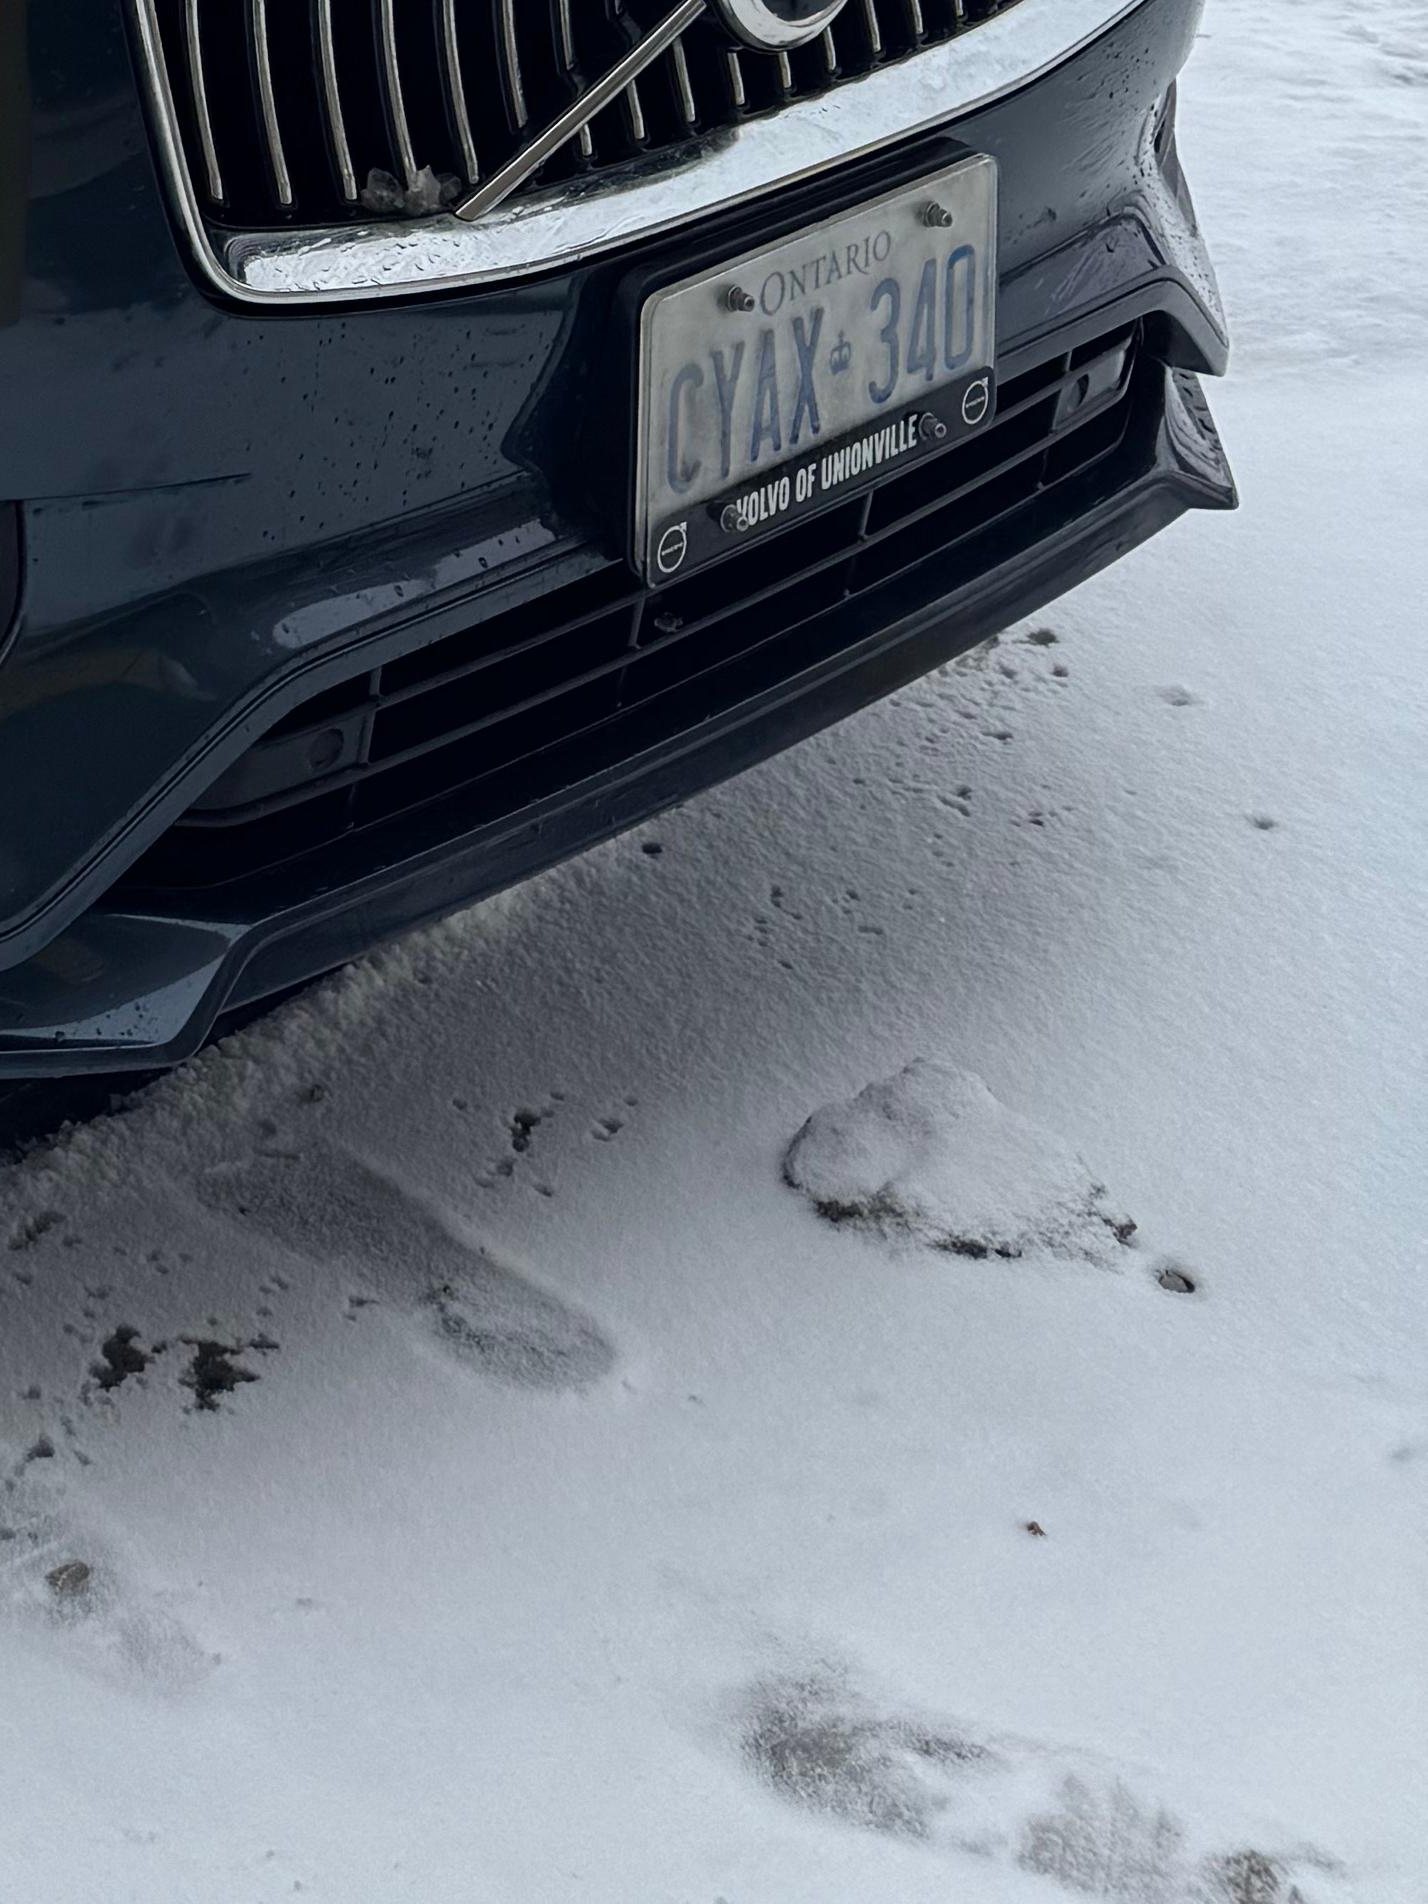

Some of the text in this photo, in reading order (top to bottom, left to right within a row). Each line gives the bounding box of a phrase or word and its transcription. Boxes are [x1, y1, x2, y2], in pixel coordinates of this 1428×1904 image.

[760, 230, 892, 316] ONTARIO
[666, 244, 976, 494] CYAX 340
[736, 414, 918, 526] VOLVO OF UNIONVILLE
